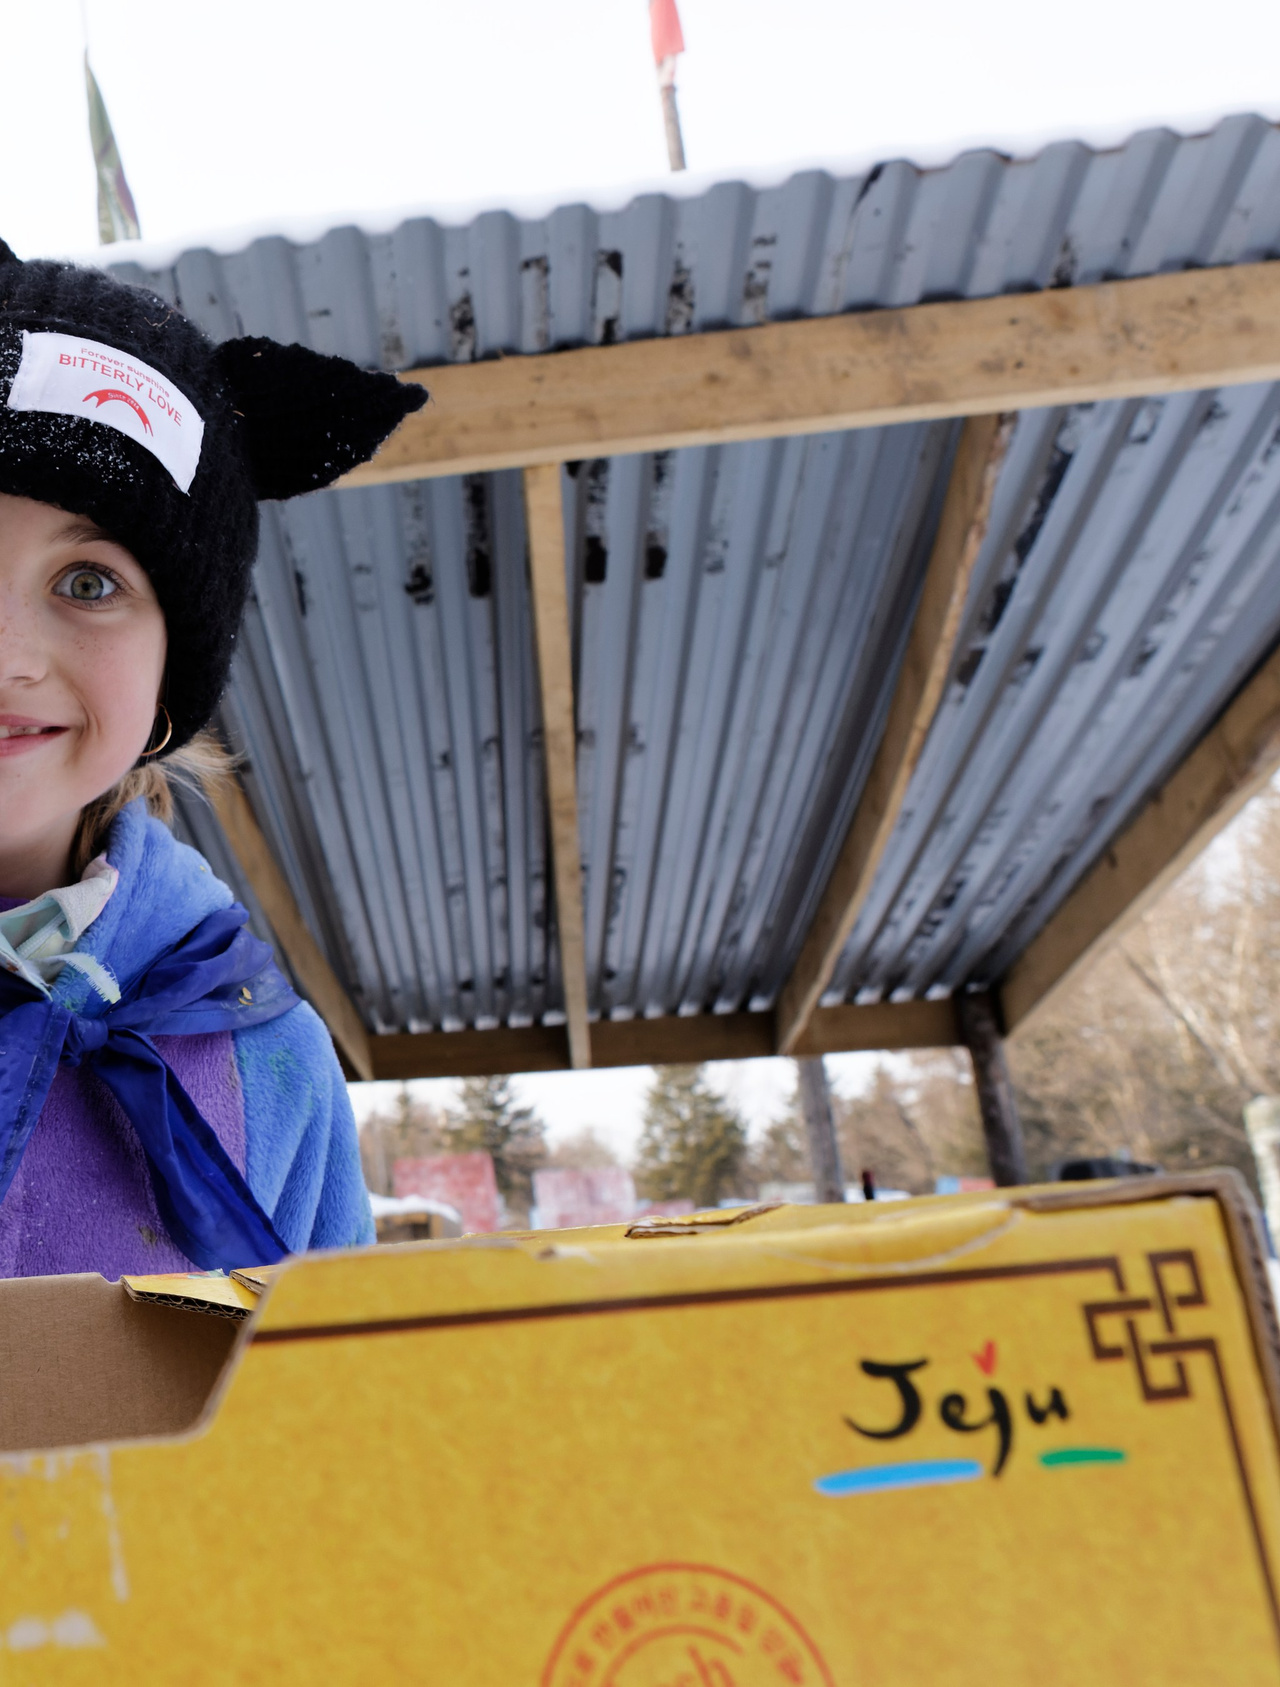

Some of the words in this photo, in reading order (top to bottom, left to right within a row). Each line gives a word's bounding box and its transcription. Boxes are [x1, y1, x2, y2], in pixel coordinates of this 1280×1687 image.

[59, 353, 144, 392] BITTERLY
[148, 387, 183, 427] LOVE
[80, 347, 124, 368] Forever
[126, 365, 170, 398] sunshine
[842, 1340, 1072, 1480] Jeju
